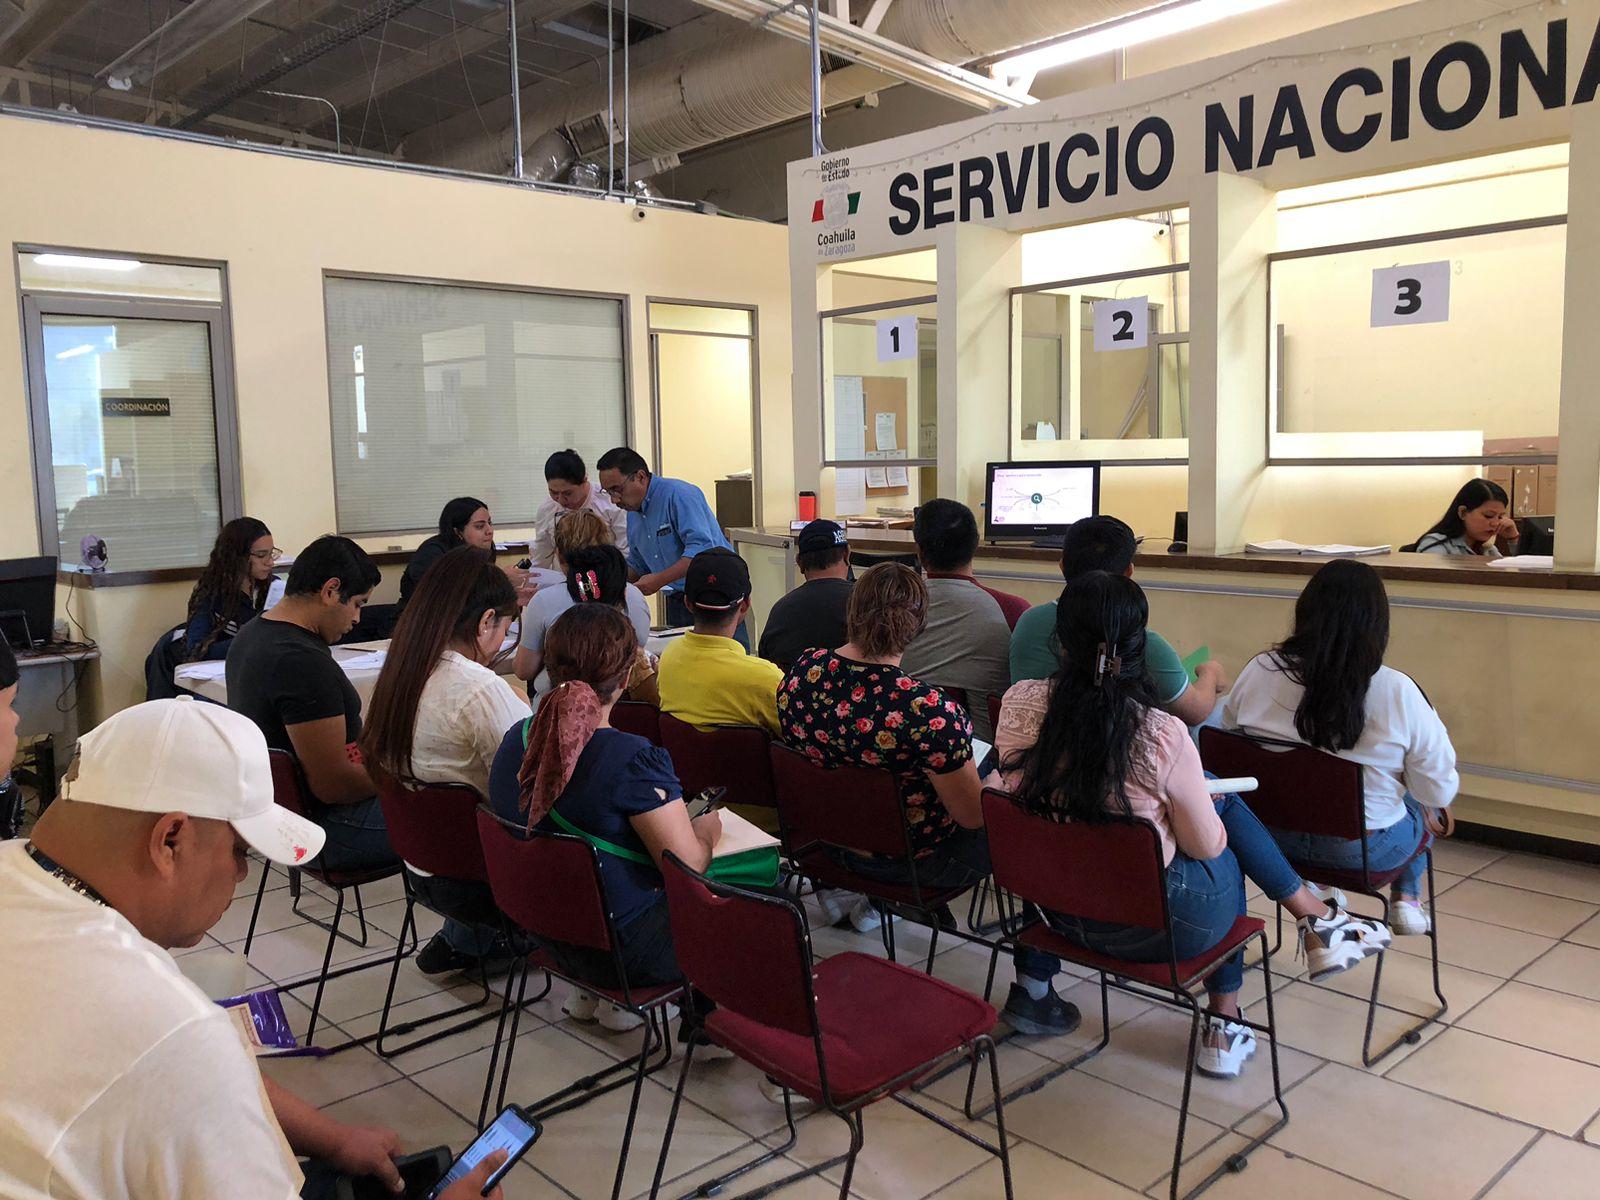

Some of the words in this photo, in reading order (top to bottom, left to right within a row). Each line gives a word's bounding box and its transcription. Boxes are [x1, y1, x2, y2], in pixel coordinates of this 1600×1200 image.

[820, 157, 850, 171] Gobierno
[828, 168, 850, 182] Estado
[888, 116, 1175, 236] SERVICIO
[817, 228, 856, 246] Coahuila
[824, 243, 856, 256] Zaragoza
[1393, 278, 1422, 315] 3
[1112, 310, 1135, 342] 2
[890, 326, 900, 353] 1
[105, 402, 169, 412] COORDINACIÓN
